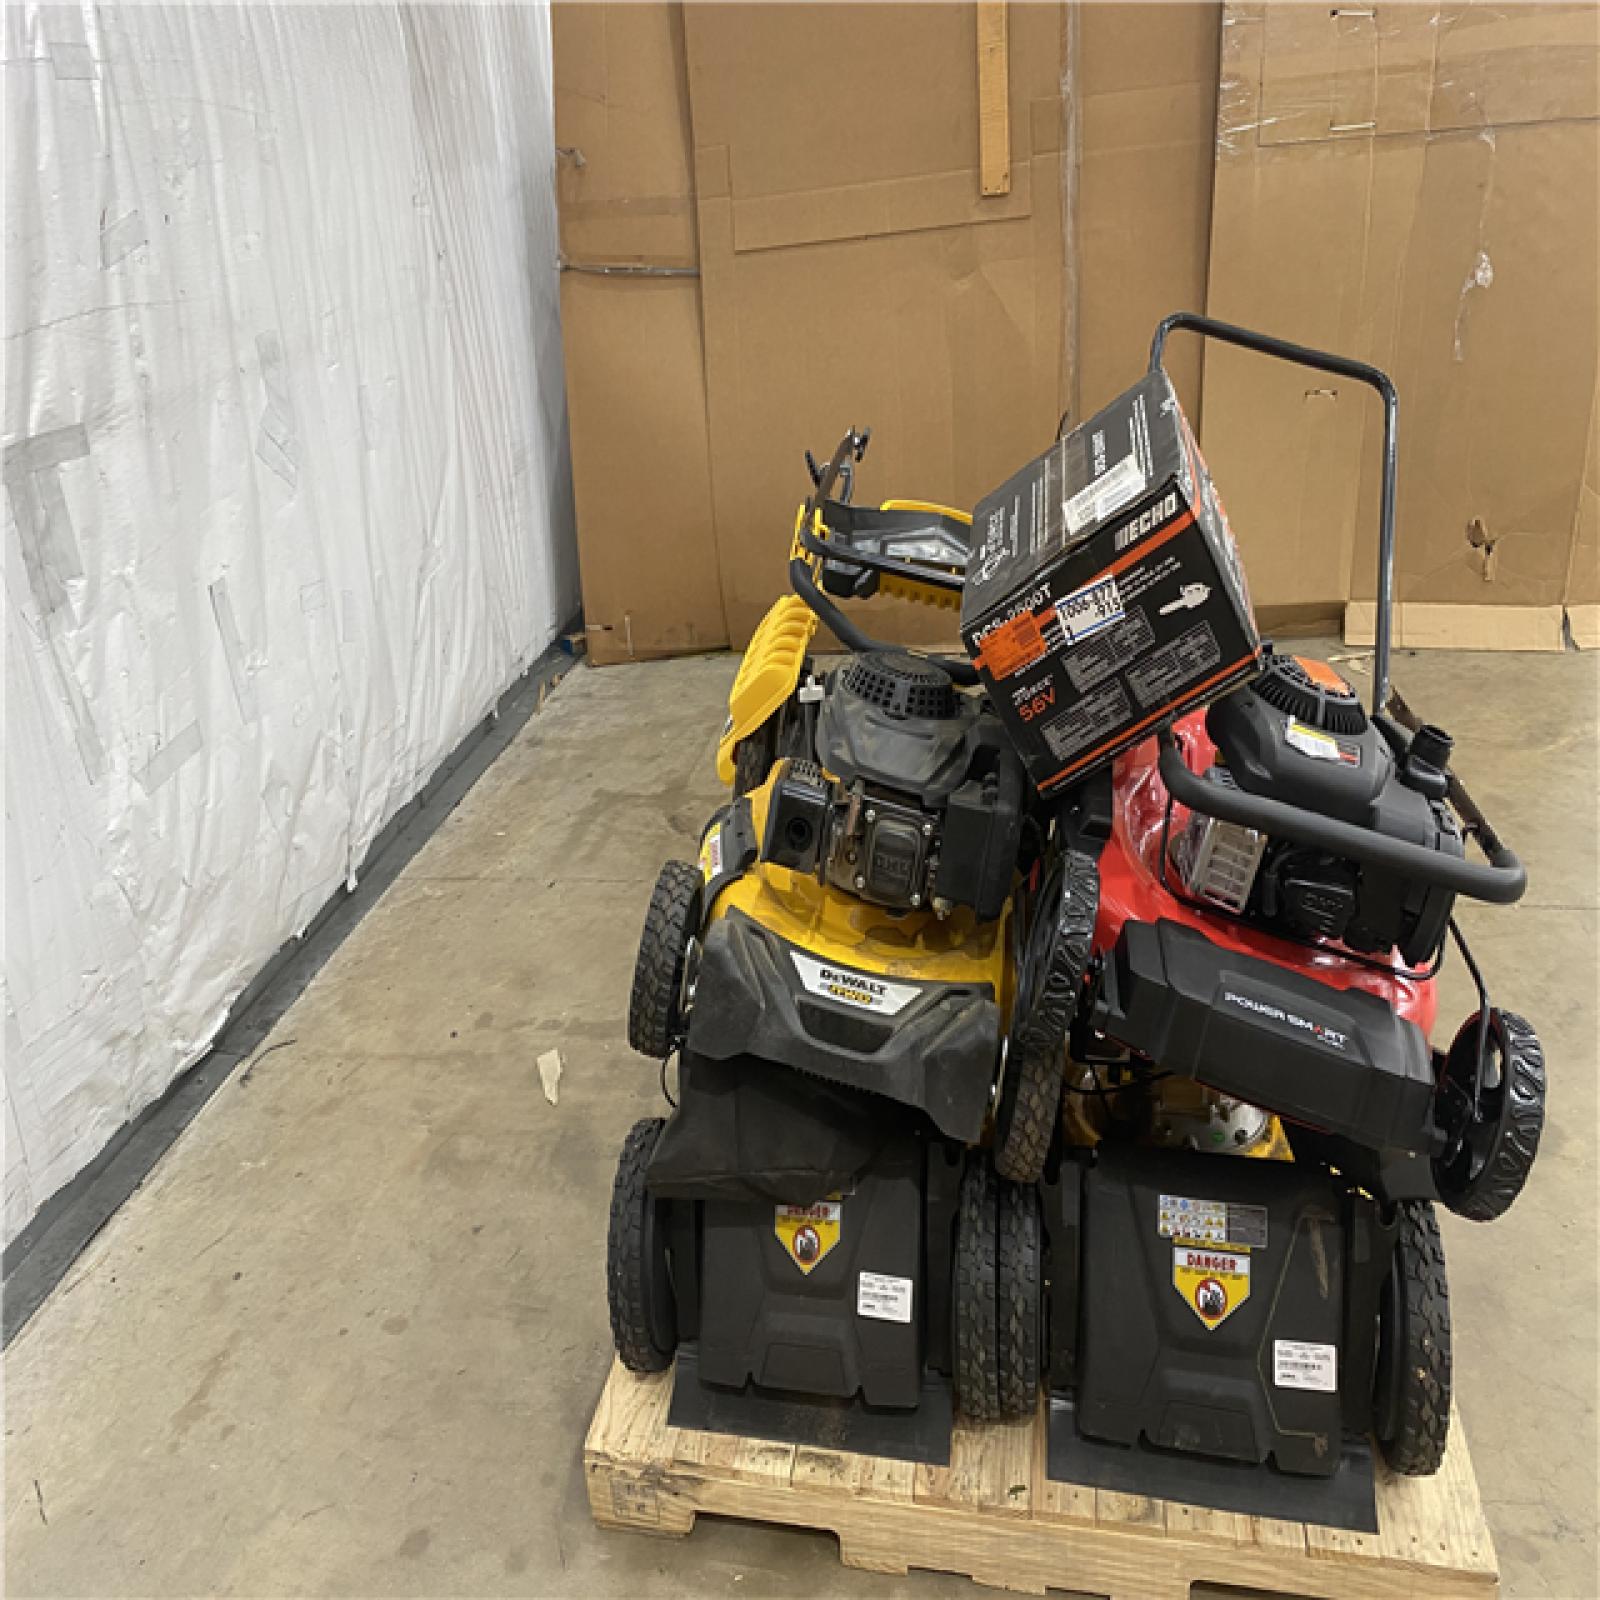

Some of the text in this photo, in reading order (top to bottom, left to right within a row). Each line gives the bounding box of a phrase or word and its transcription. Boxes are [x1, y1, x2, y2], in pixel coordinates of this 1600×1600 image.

[1128, 492, 1177, 542] ECHO
[1018, 687, 1056, 721] 56V
[1186, 1251, 1238, 1272] DANGER
